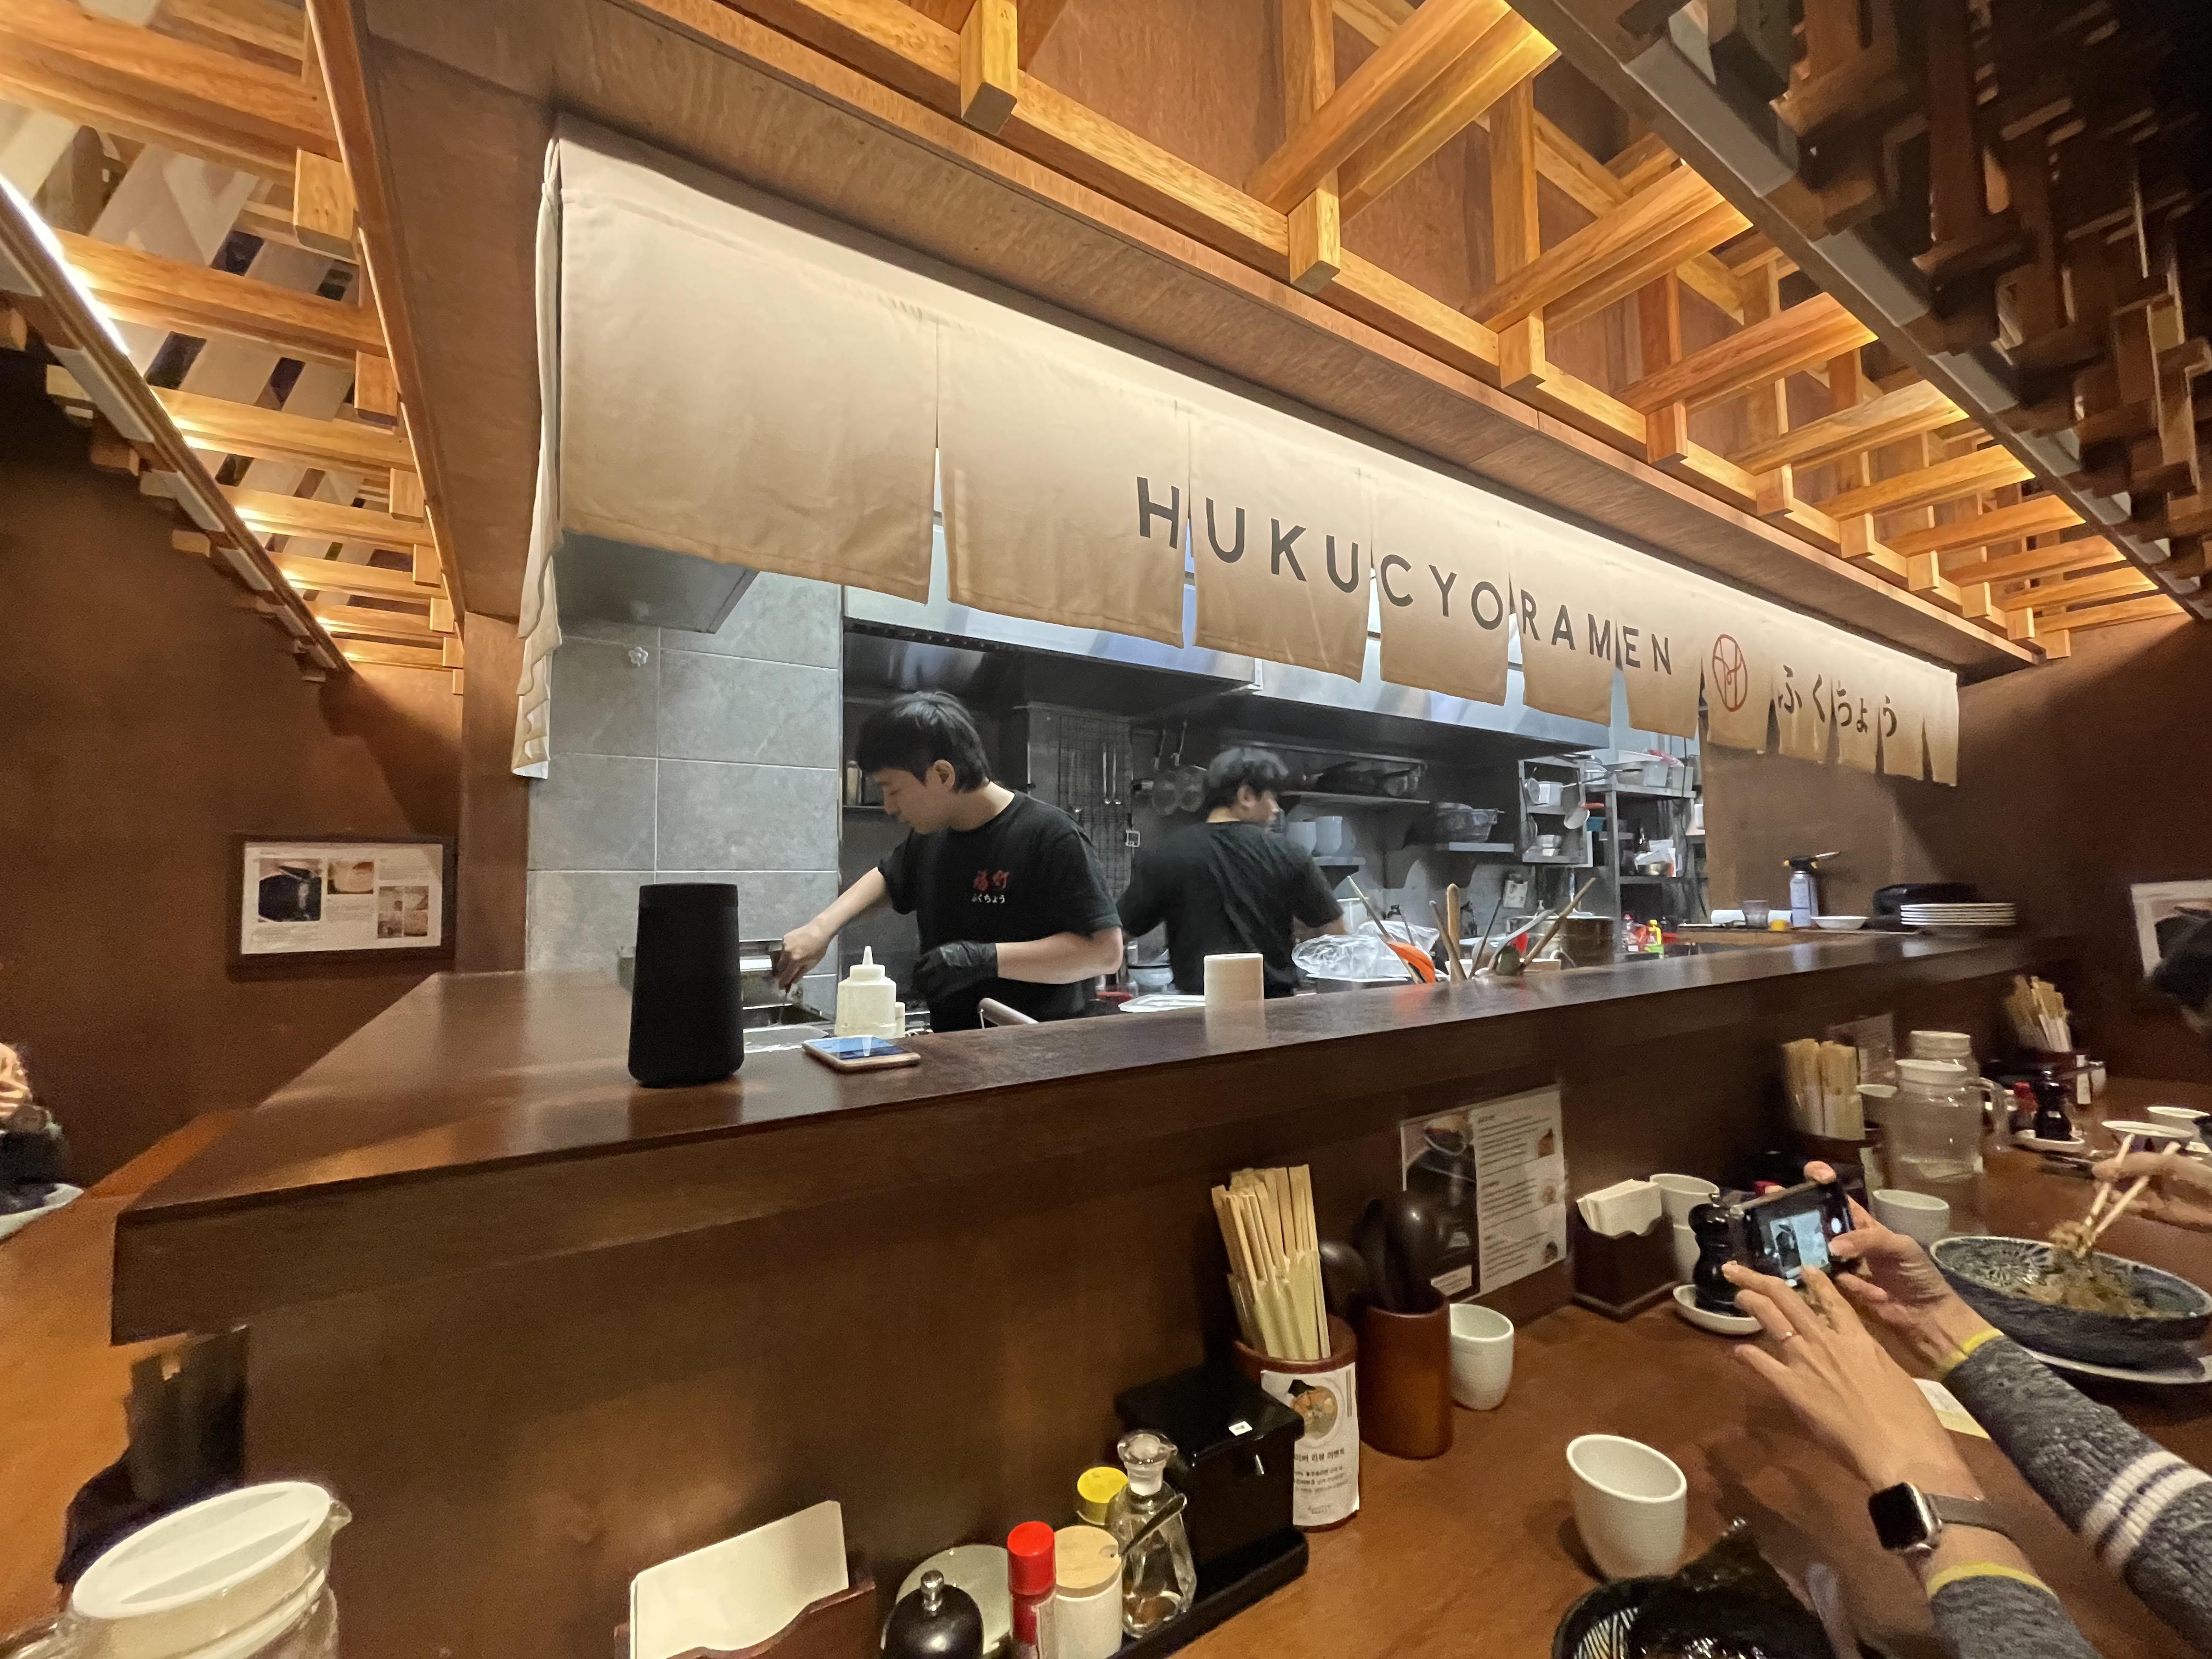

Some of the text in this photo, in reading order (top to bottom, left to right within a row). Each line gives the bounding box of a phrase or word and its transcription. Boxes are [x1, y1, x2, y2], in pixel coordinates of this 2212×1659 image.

[1778, 664, 1897, 737] ふくちょう
